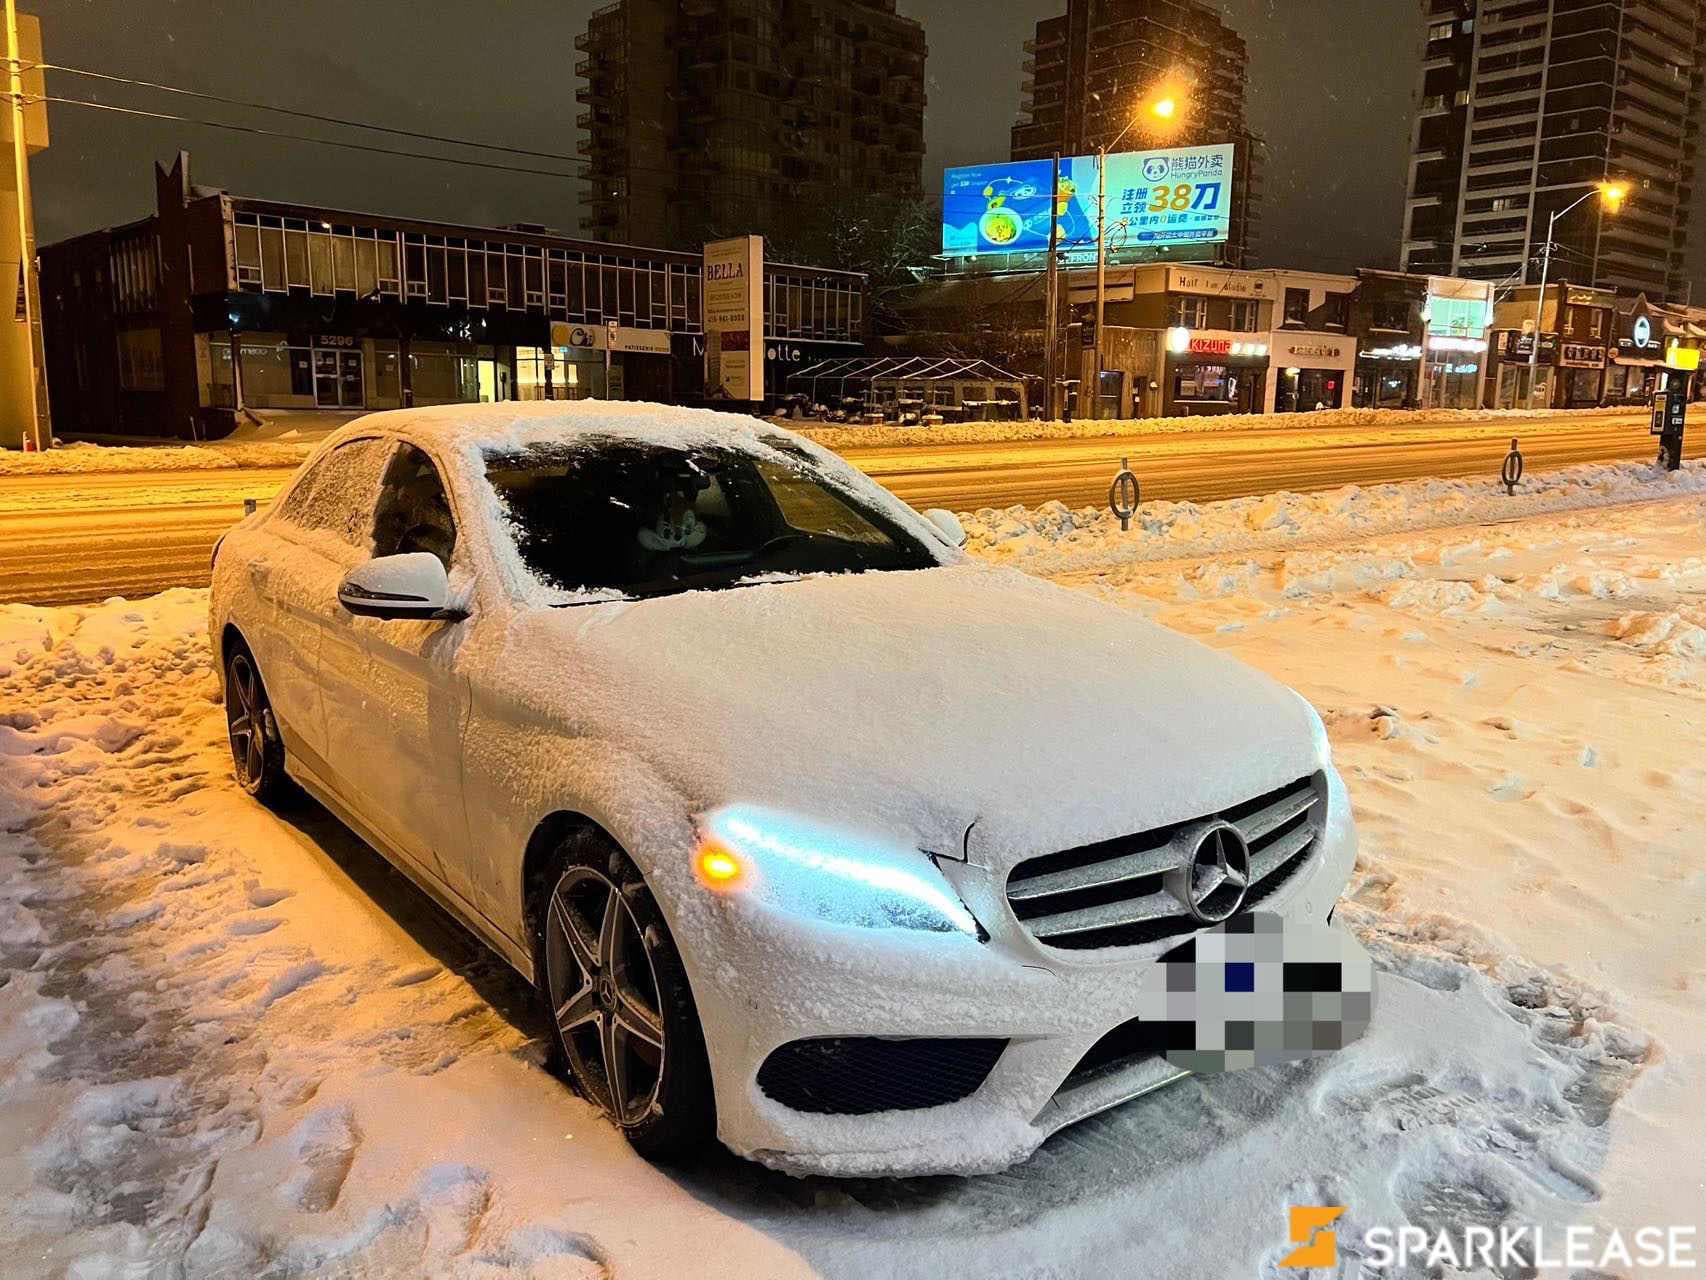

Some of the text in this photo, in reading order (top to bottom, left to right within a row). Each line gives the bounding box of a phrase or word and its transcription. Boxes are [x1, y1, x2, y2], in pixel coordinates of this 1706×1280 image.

[1171, 154, 1223, 171] 熊猫外卖
[1122, 188, 1148, 201] 注册
[707, 263, 743, 281] BELLA
[320, 335, 353, 346] 5296
